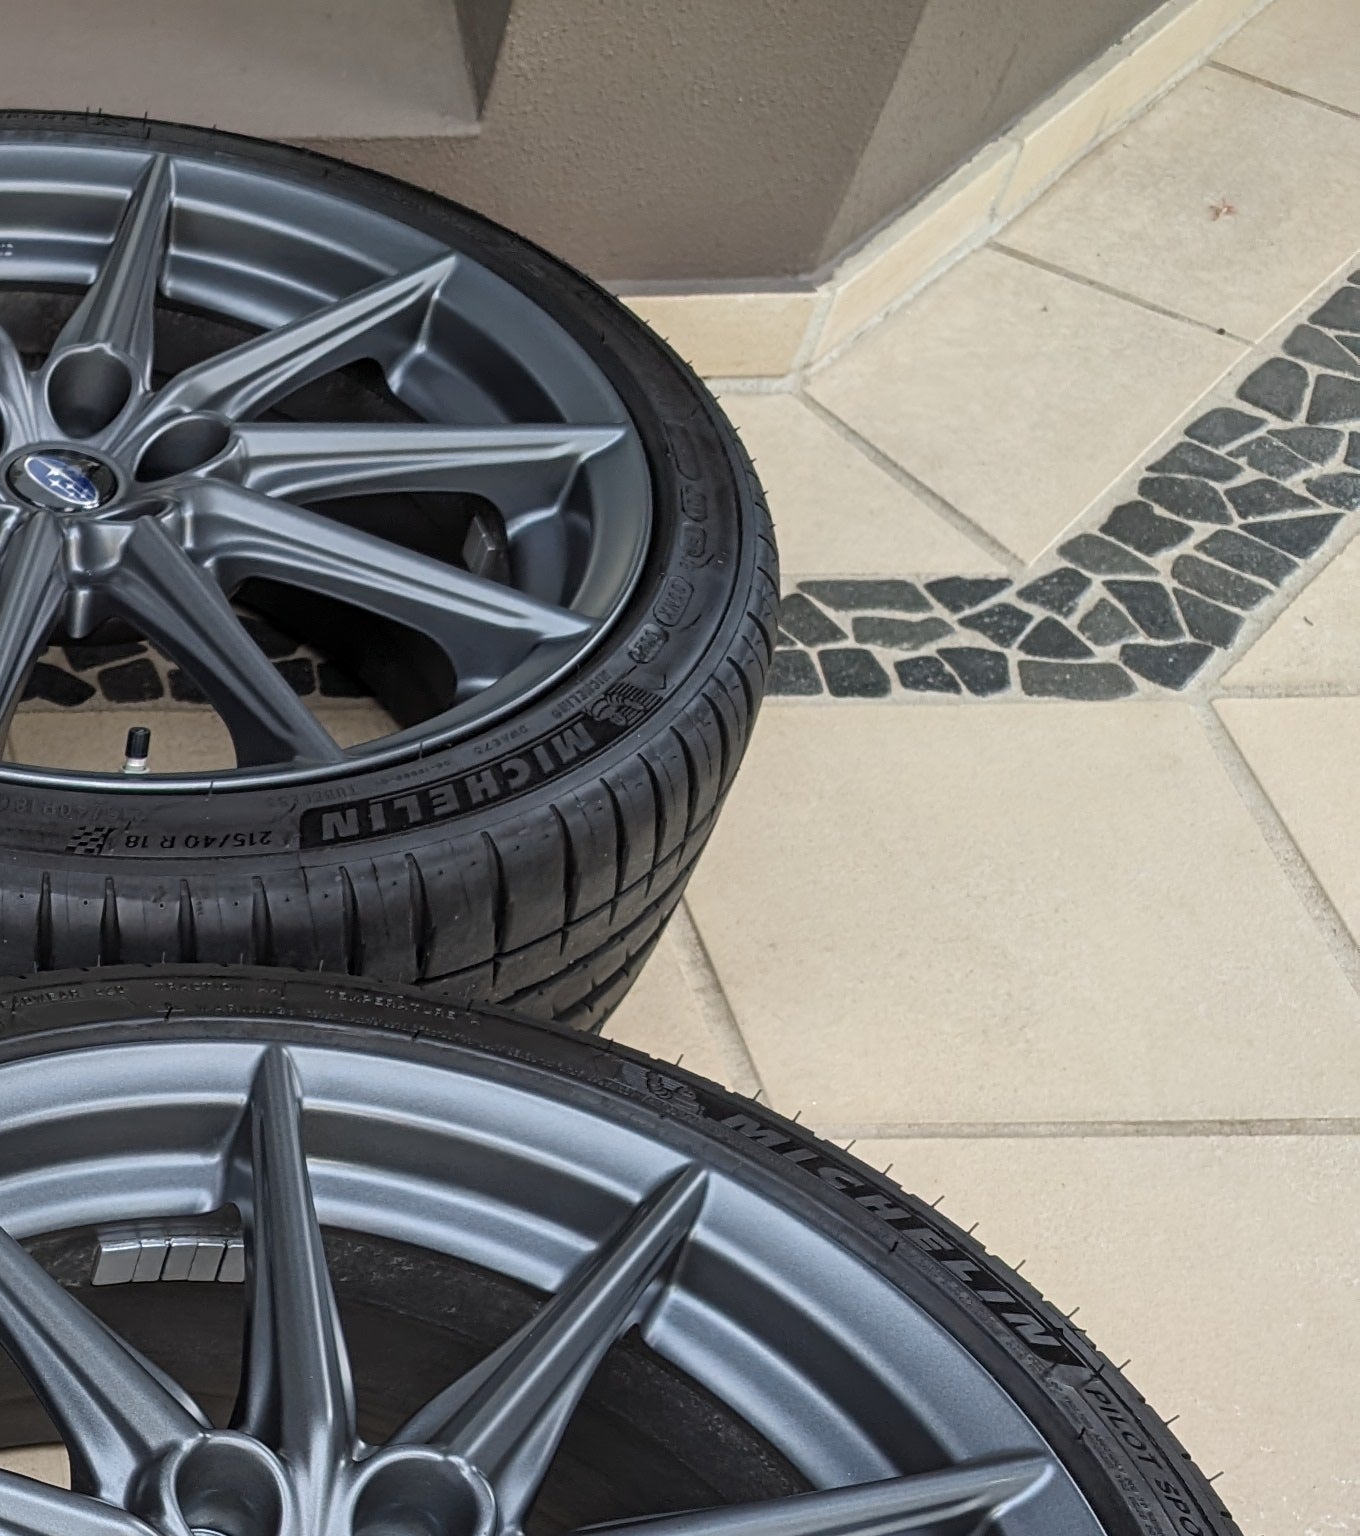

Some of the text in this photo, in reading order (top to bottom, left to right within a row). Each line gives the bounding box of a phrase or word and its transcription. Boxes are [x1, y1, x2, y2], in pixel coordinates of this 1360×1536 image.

[124, 828, 276, 850] 215/40 R 18
[307, 722, 609, 840] MICHELIN
[717, 1107, 1061, 1354] MICHELIN
[1083, 1383, 1162, 1470] PILOT
